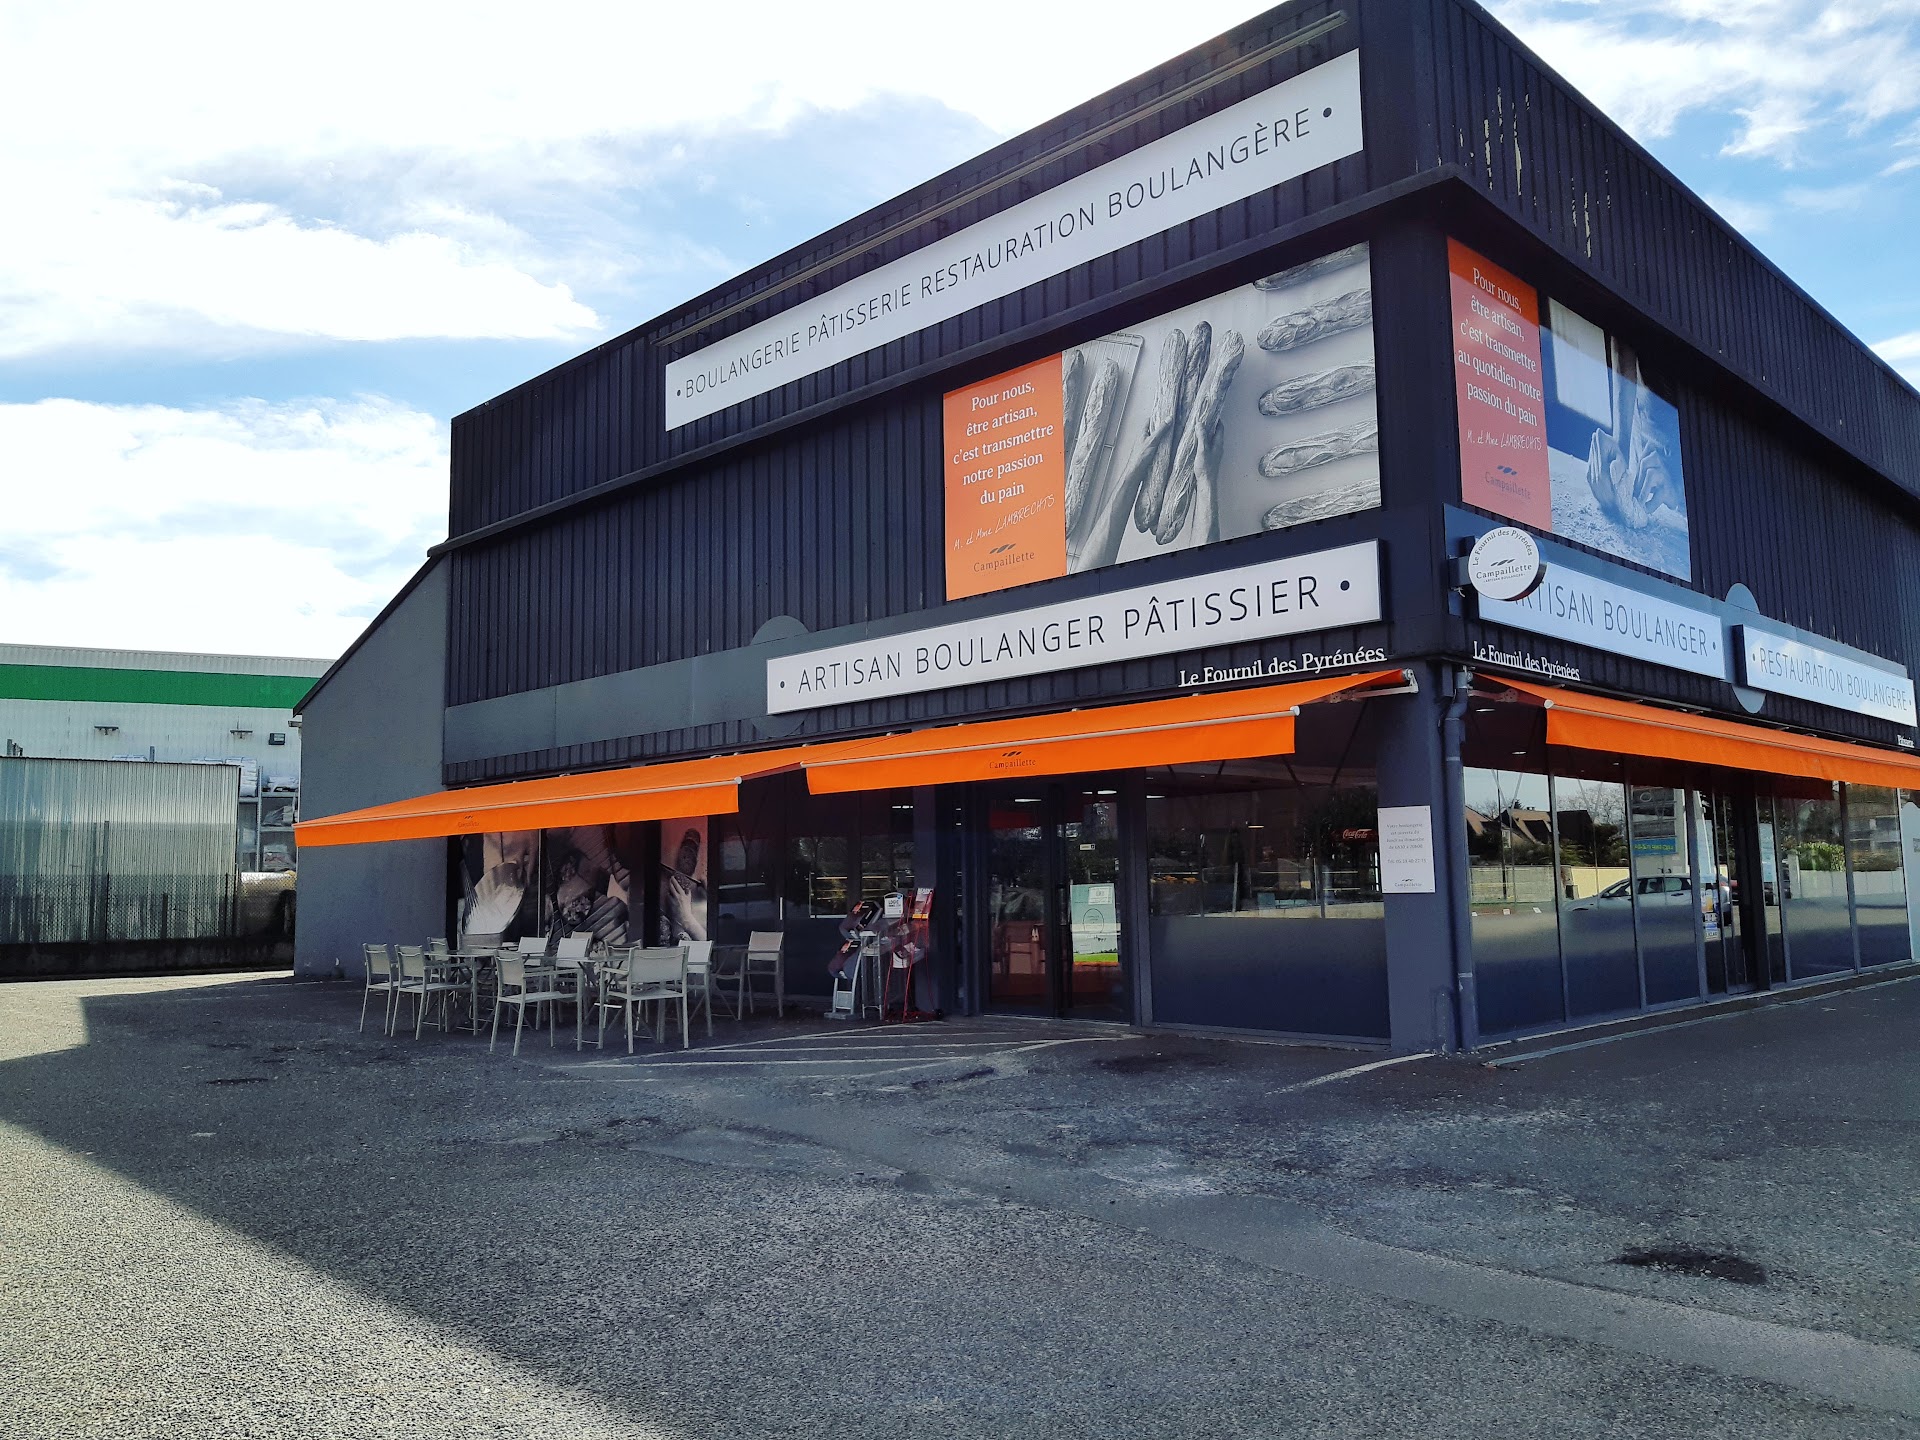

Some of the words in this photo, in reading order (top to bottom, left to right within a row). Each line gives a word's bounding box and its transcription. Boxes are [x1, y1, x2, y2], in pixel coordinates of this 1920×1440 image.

[685, 332, 800, 398] BOULANGERIE
[808, 284, 911, 346] PÂTISSERIE
[921, 203, 1094, 299] RESTAURATION
[1109, 107, 1310, 218] BOULANGÈRE
[1473, 267, 1495, 293] Pour
[1498, 286, 1522, 314] nous,
[1471, 295, 1490, 319] être
[1491, 311, 1525, 343] artisan,
[1485, 332, 1536, 373] transmettre
[1458, 349, 1471, 366] au
[1472, 356, 1516, 391] quotidien
[1518, 379, 1541, 402] notre
[971, 392, 999, 412] Pour
[1002, 381, 1035, 402] nous,
[1466, 382, 1502, 410] passion
[1504, 397, 1516, 417] du
[1519, 406, 1538, 427] pain
[966, 419, 989, 437] être
[991, 405, 1038, 430] artisan,
[1501, 432, 1542, 451] LAMBRECHTS
[953, 445, 979, 465] c'est
[982, 424, 1054, 457] transmettre
[962, 465, 994, 486] notre
[997, 452, 1044, 479] passion
[1485, 471, 1531, 500] Campaillette
[980, 489, 995, 505] du
[998, 482, 1025, 504] pain
[995, 493, 1055, 534] LAMBRECHTS
[973, 551, 1035, 573] Campaillette
[1472, 557, 1480, 566] Le
[1475, 532, 1496, 555] Fournil
[1511, 530, 1533, 556] Pyrénées
[1476, 565, 1532, 580] Campaillette
[798, 651, 902, 694] ARTISAN
[917, 616, 1105, 675] BOULANGER
[1124, 575, 1319, 640] PÂTISSIER
[1604, 600, 1708, 657] BOULANGER
[1178, 670, 1199, 688] Le
[1203, 659, 1263, 685] Fournil
[1268, 657, 1297, 674] des
[1302, 646, 1386, 674] Pyrénées
[1473, 640, 1486, 661] Le
[1488, 645, 1522, 668] Fournil
[1525, 653, 1540, 671] des
[1541, 657, 1581, 681] Pyrénées
[1760, 647, 1843, 694] RESTAURATION
[989, 759, 1036, 769] Campaillette
